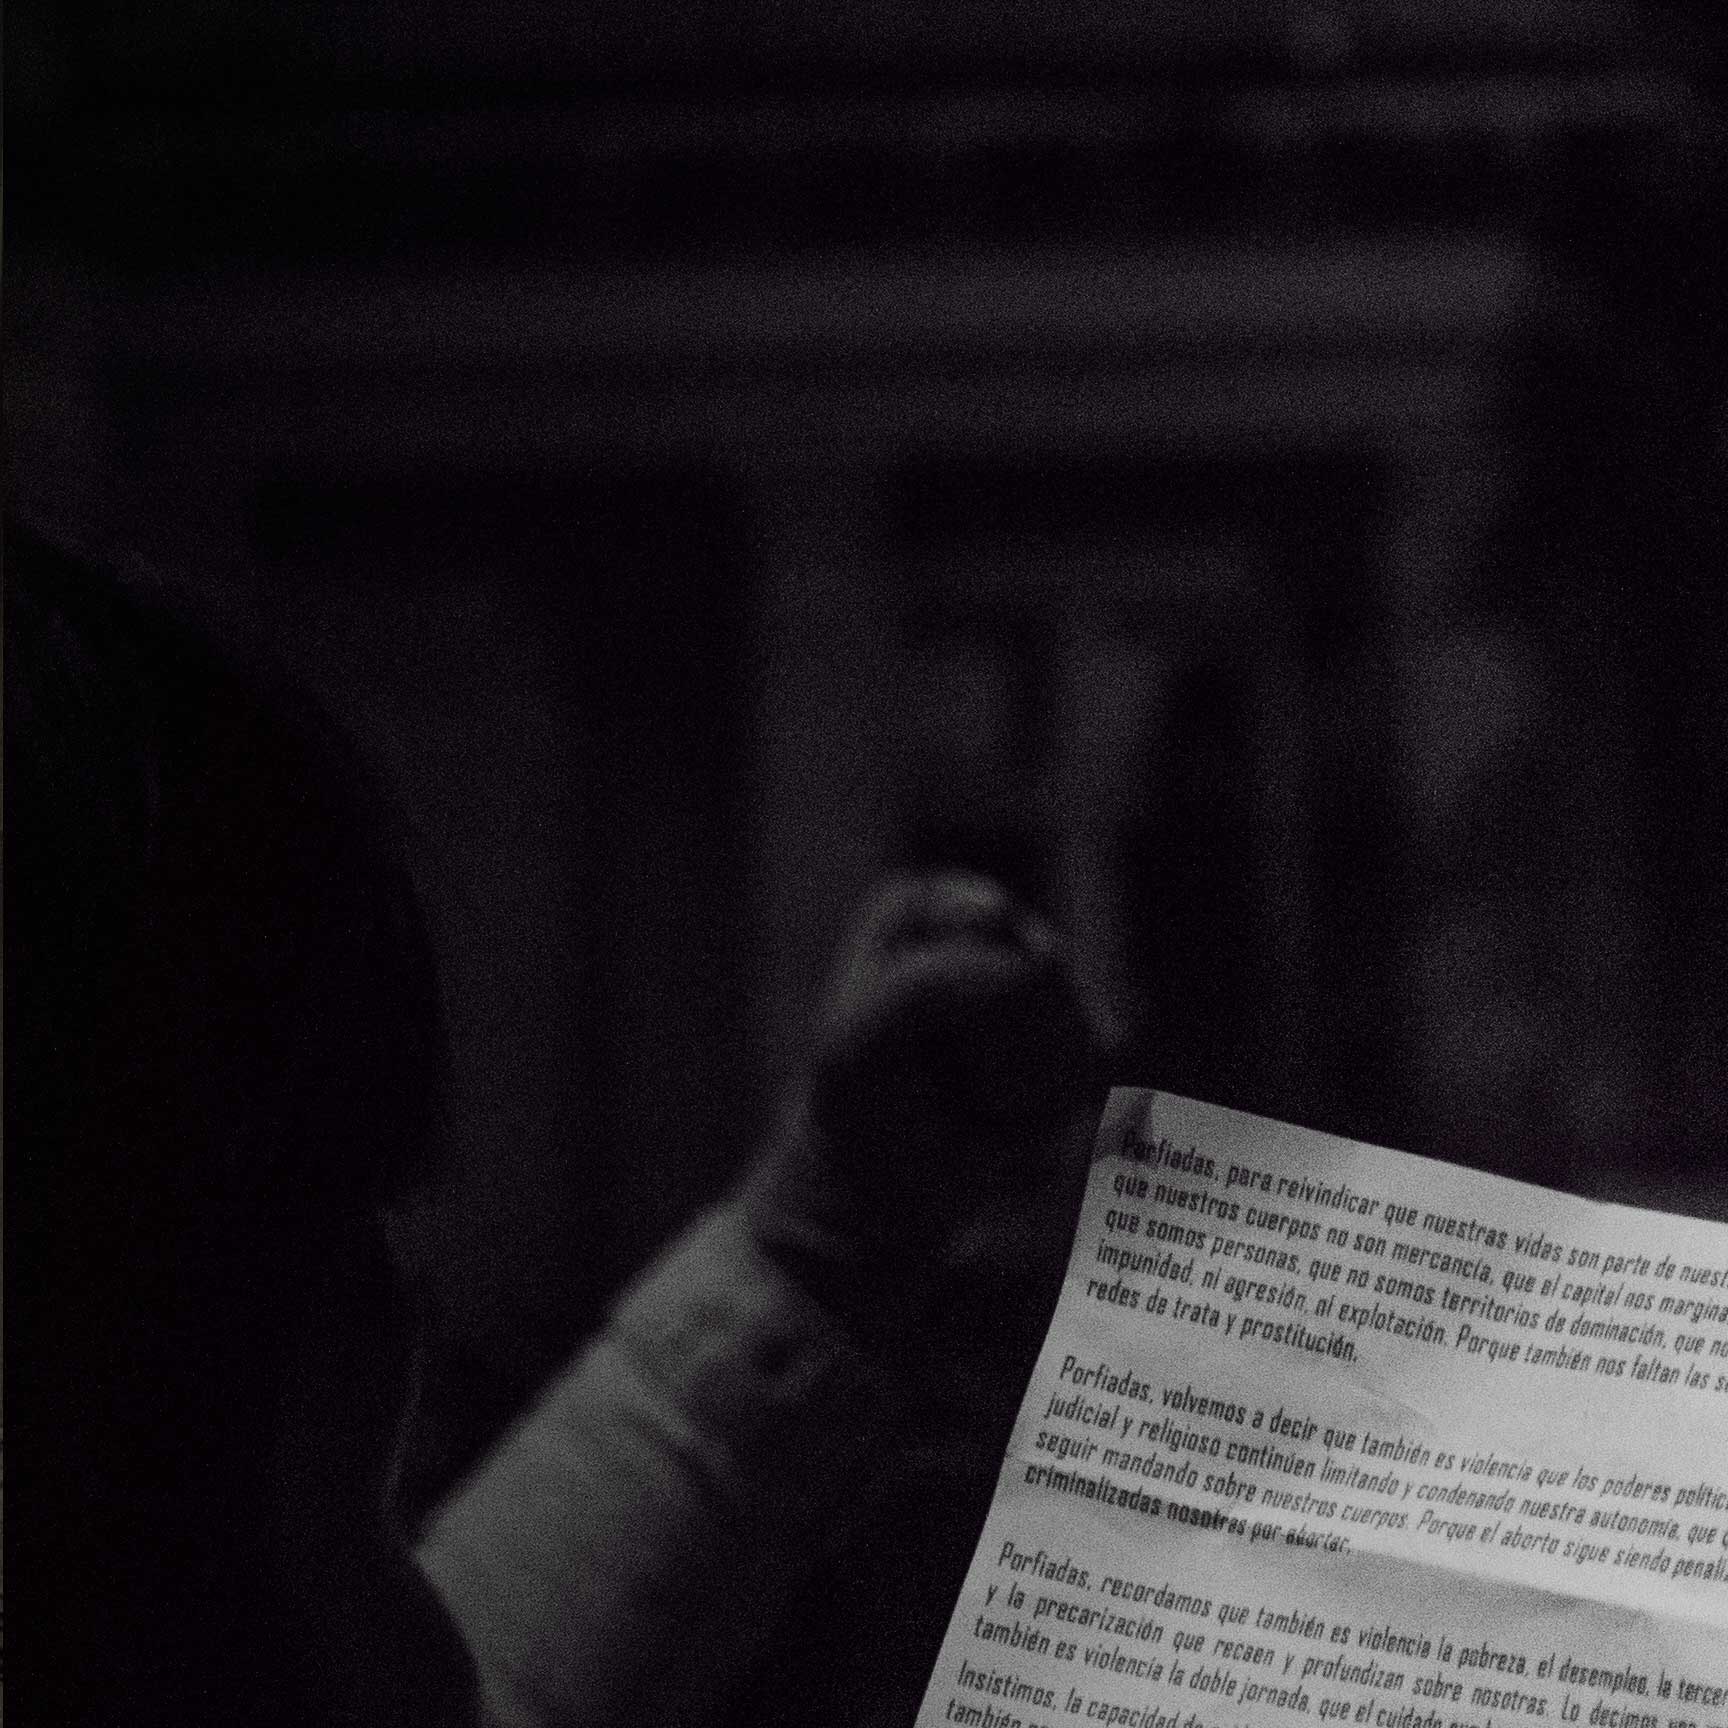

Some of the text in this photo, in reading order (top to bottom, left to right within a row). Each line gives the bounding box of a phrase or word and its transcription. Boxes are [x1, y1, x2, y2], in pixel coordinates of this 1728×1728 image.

[1085, 1276, 1142, 1310] redes
[1144, 1287, 1169, 1317] de
[1171, 1296, 1221, 1328] trata
[1223, 1313, 1238, 1337] y
[1103, 1208, 1141, 1236] que
[1144, 1218, 1212, 1251] somos
[1307, 1258, 1343, 1283] que
[1345, 1267, 1371, 1290] no
[1373, 1274, 1436, 1306] somos
[1440, 1286, 1541, 1329] territorios
[1543, 1309, 1568, 1334] de
[1673, 1333, 1706, 1355] que
[1161, 1385, 1247, 1426] volvemos
[1250, 1408, 1266, 1430] a
[1268, 1406, 1319, 1442] decir
[1321, 1426, 1358, 1452] que
[1360, 1431, 1431, 1465] también
[1433, 1451, 1457, 1471] es
[1459, 1452, 1534, 1482] violencia
[1535, 1467, 1570, 1489] que
[1571, 1465, 1600, 1492] los
[1599, 1473, 1673, 1503] poderes
[973, 1615, 1051, 1655] también
[1053, 1639, 1078, 1662] es
[1083, 1644, 1165, 1683] violencia
[1167, 1659, 1186, 1687] la
[1188, 1665, 1238, 1698] doble
[1317, 1697, 1352, 1722] que
[1353, 1698, 1376, 1724] el
[1099, 1576, 1213, 1618] recordamos
[1216, 1603, 1251, 1627] que
[1254, 1607, 1326, 1640] también
[1328, 1624, 1352, 1646] es
[1357, 1625, 1432, 1659] violencia
[1436, 1635, 1454, 1664] la
[1535, 1652, 1557, 1680] el
[1656, 1670, 1674, 1700] la
